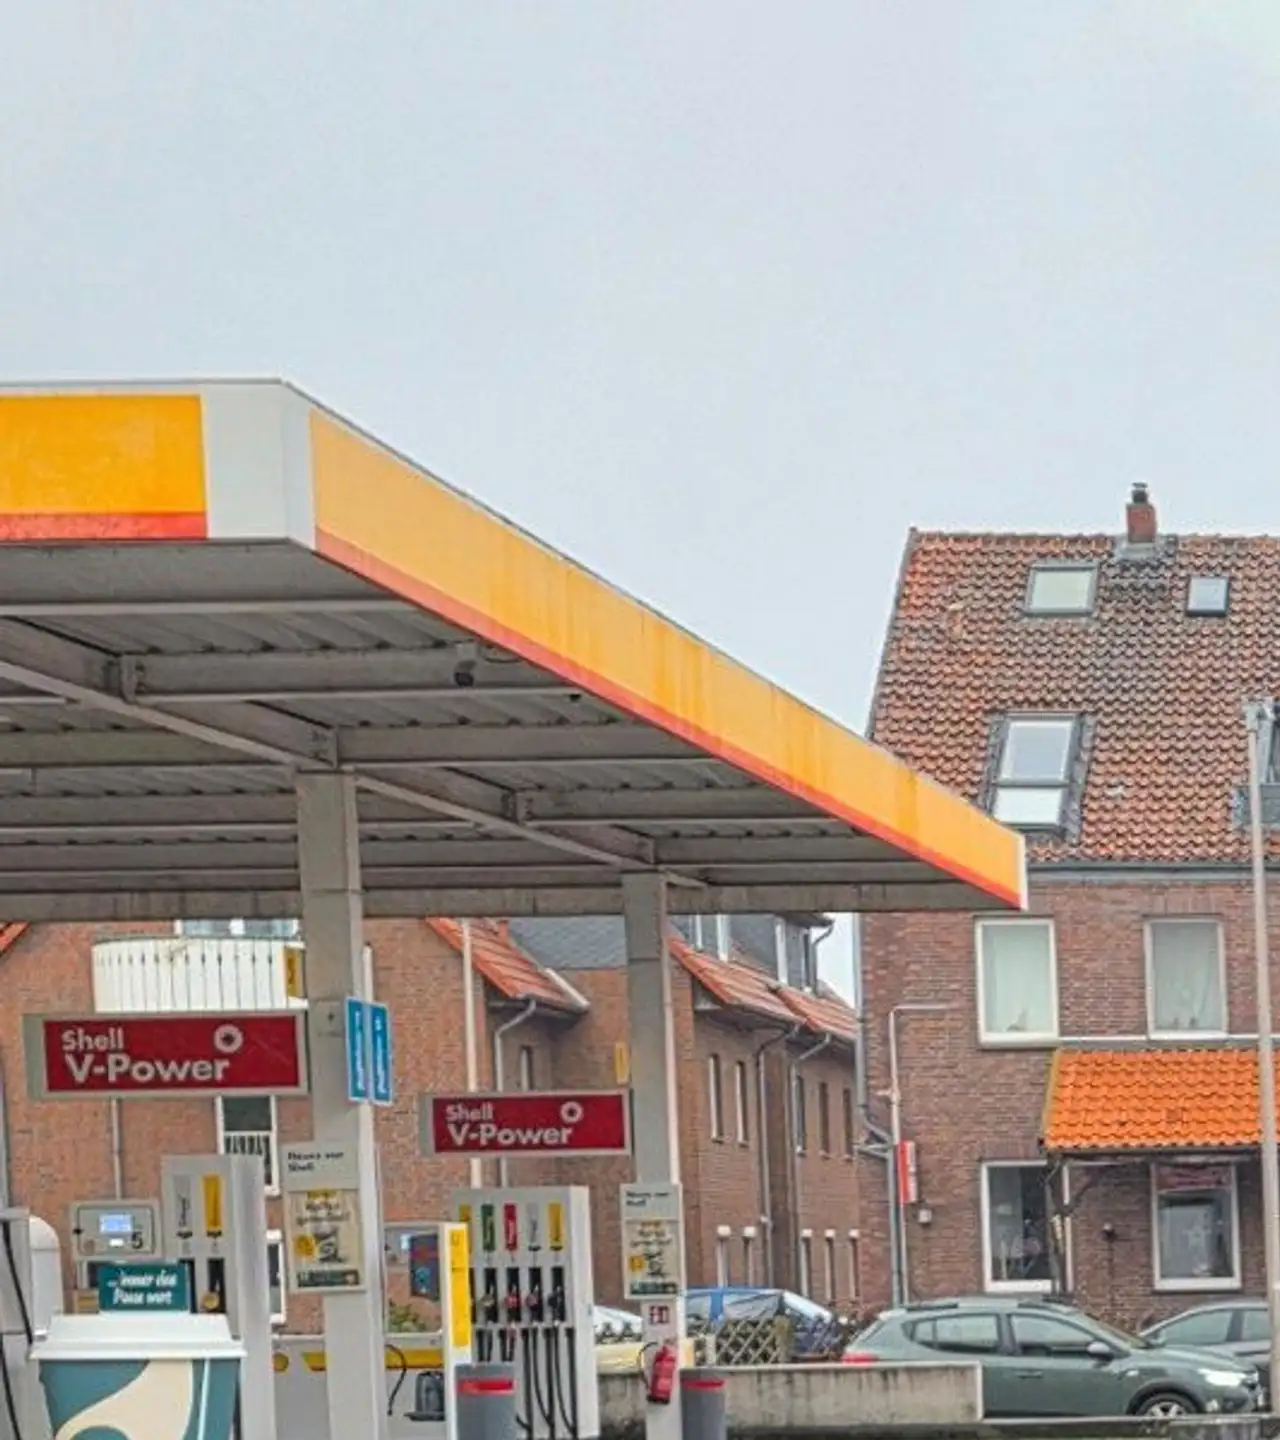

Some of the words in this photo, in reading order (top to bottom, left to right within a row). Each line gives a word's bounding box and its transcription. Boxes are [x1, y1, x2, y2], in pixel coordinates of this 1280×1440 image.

[61, 1027, 124, 1051] Shell
[64, 1052, 231, 1083] V-Power
[445, 1102, 494, 1121] Shell
[447, 1122, 573, 1146] V-Power
[131, 1231, 144, 1249] 5
